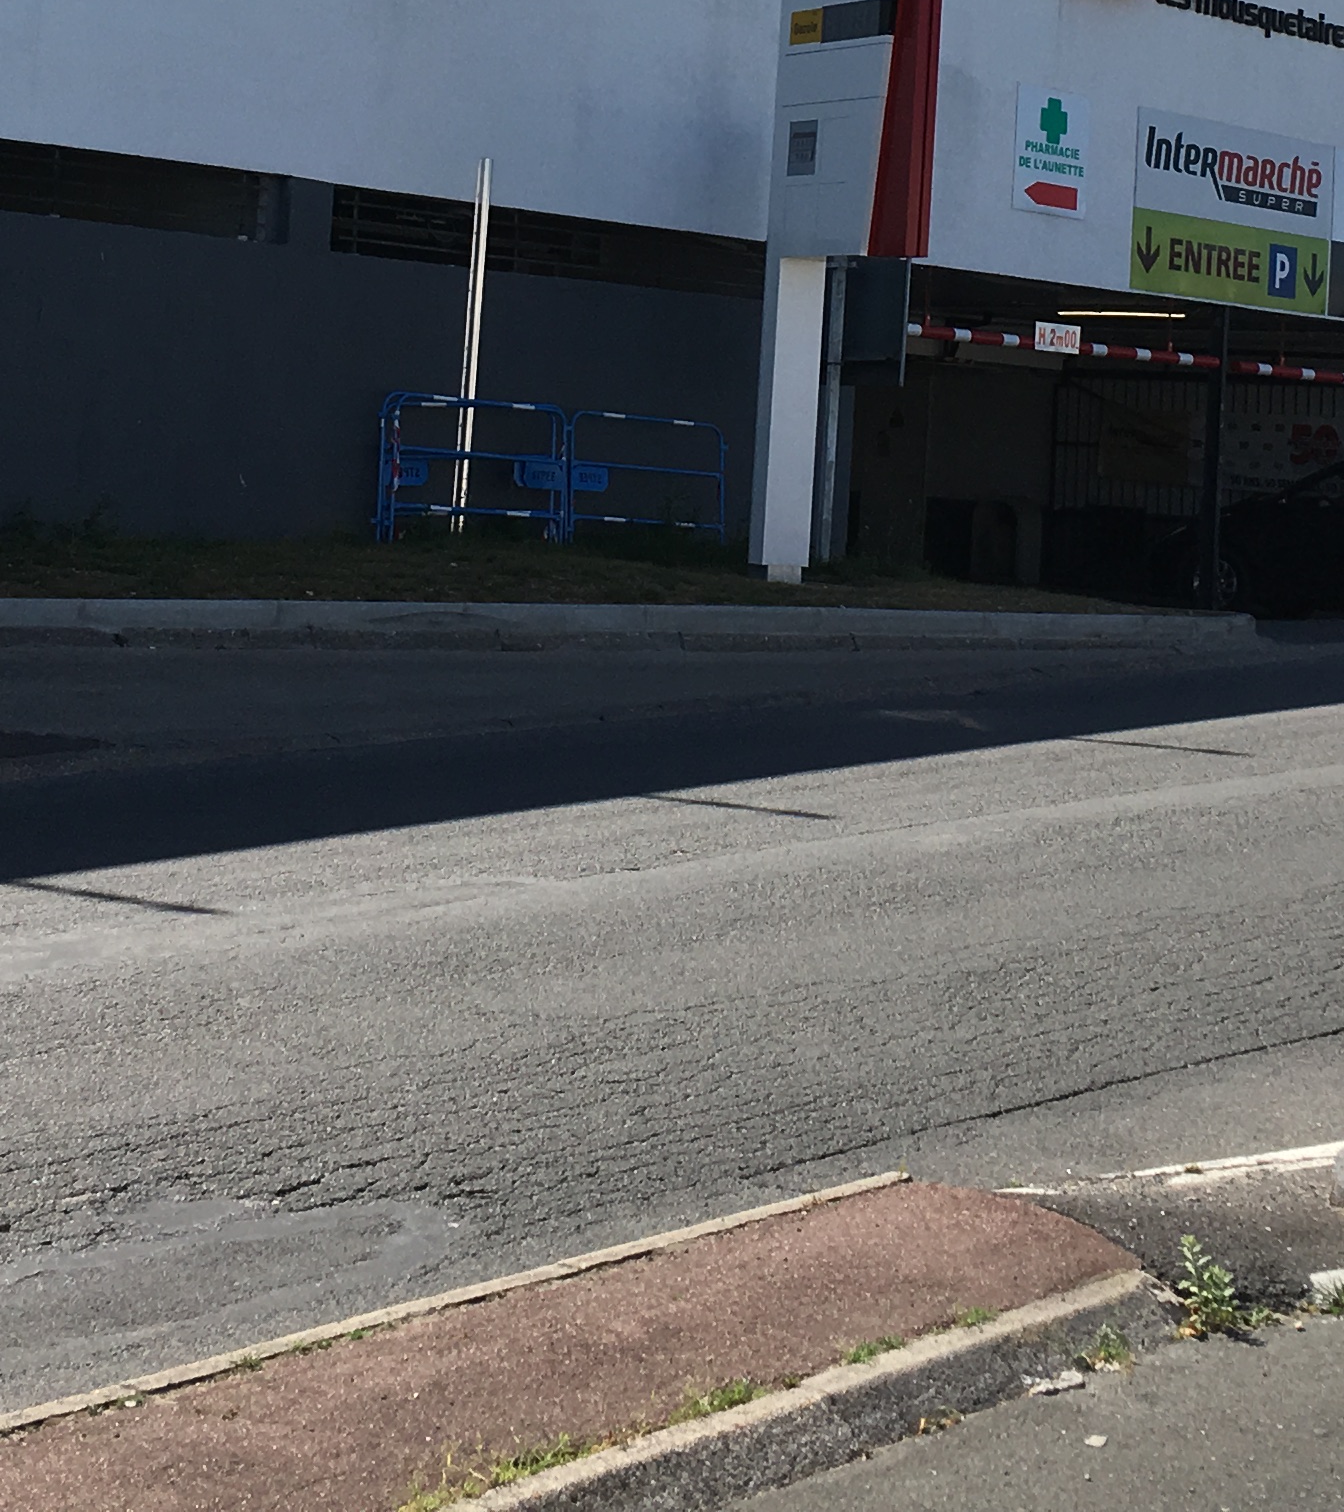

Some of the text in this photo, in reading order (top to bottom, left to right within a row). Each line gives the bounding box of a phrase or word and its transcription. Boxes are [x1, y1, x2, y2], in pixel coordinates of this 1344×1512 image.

[1025, 139, 1080, 160] PHARMACIE
[1018, 155, 1084, 178] DE L'AUNETTE
[1145, 125, 1322, 200] Intermarché
[1168, 238, 1290, 289] ENTREE P
[1038, 327, 1046, 345] H
